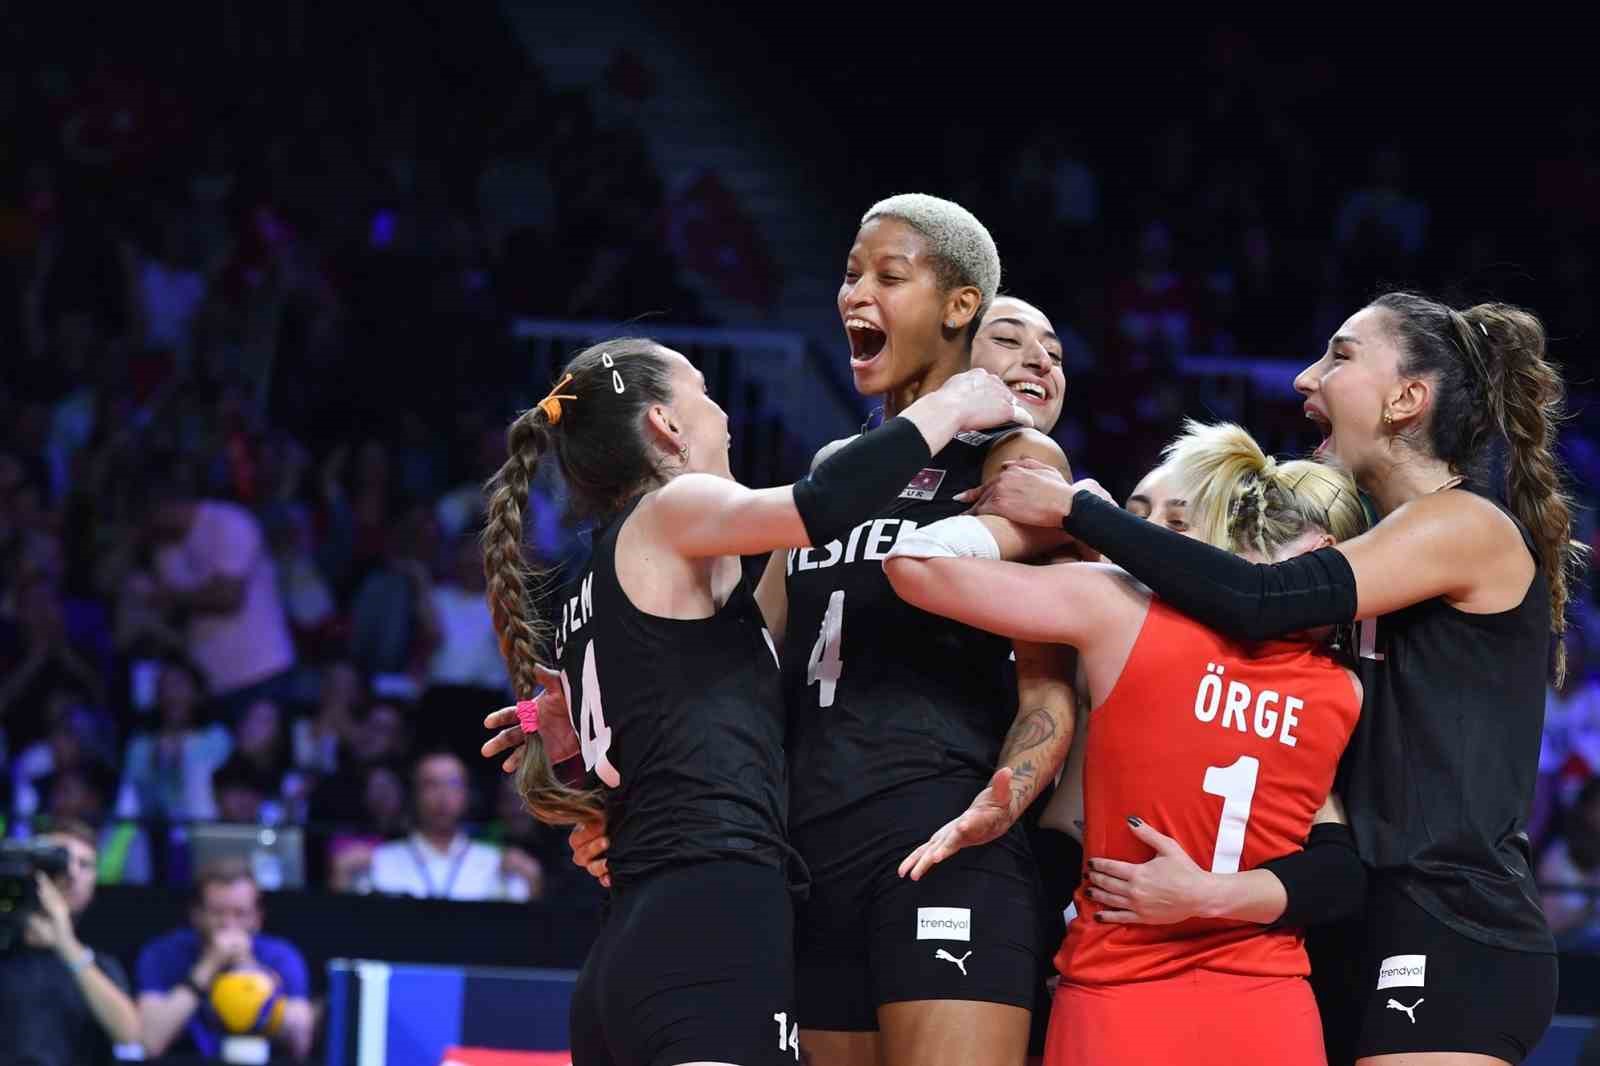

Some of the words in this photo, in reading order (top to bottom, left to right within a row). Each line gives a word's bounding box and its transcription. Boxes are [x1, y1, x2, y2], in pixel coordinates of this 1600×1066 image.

[807, 590, 845, 708] 4
[1195, 662, 1304, 747] ÖRGE
[1202, 754, 1260, 874] 1
[920, 918, 969, 930] trendyol
[774, 1011, 799, 1061] 14
